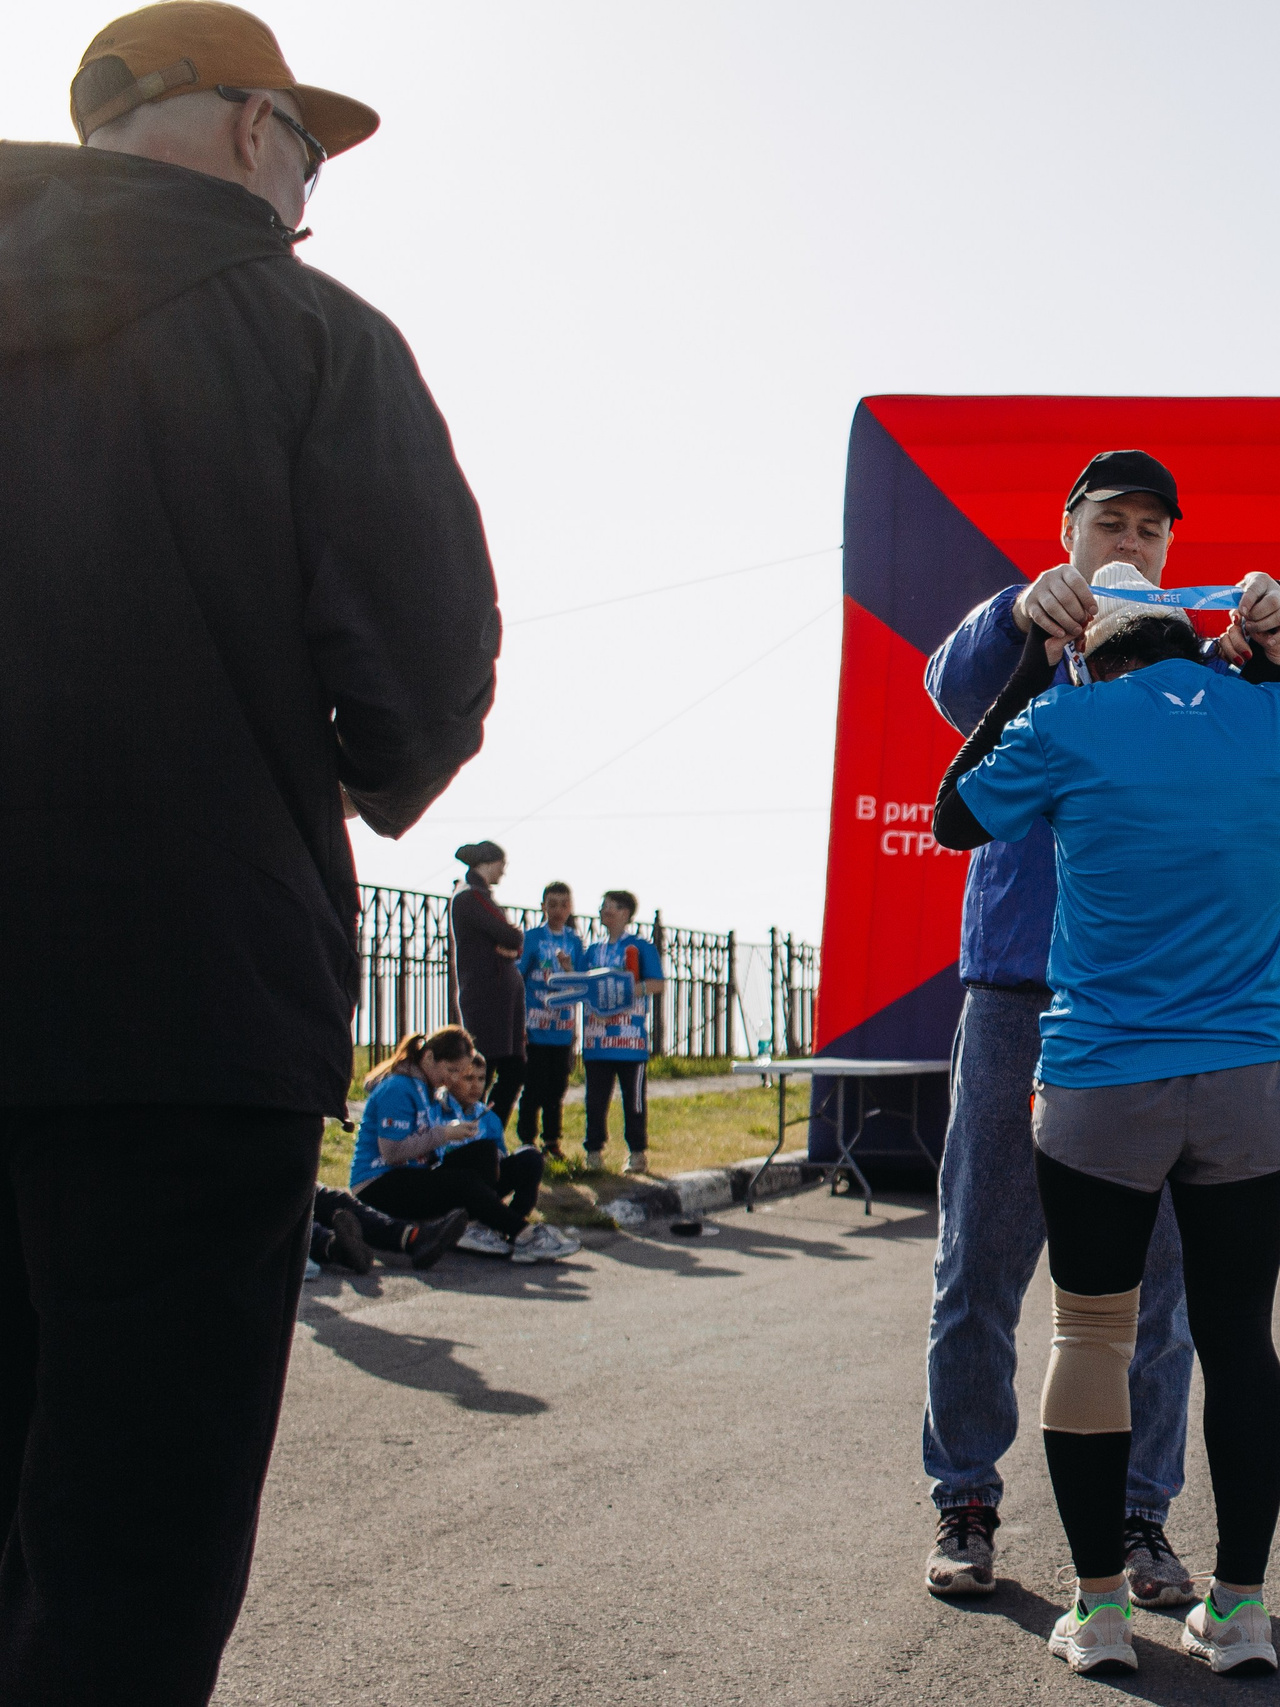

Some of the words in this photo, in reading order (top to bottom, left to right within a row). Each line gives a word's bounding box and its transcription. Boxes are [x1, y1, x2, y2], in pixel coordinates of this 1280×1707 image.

[856, 795, 877, 820] В
[883, 802, 935, 825] рит
[882, 830, 963, 856] СТР
